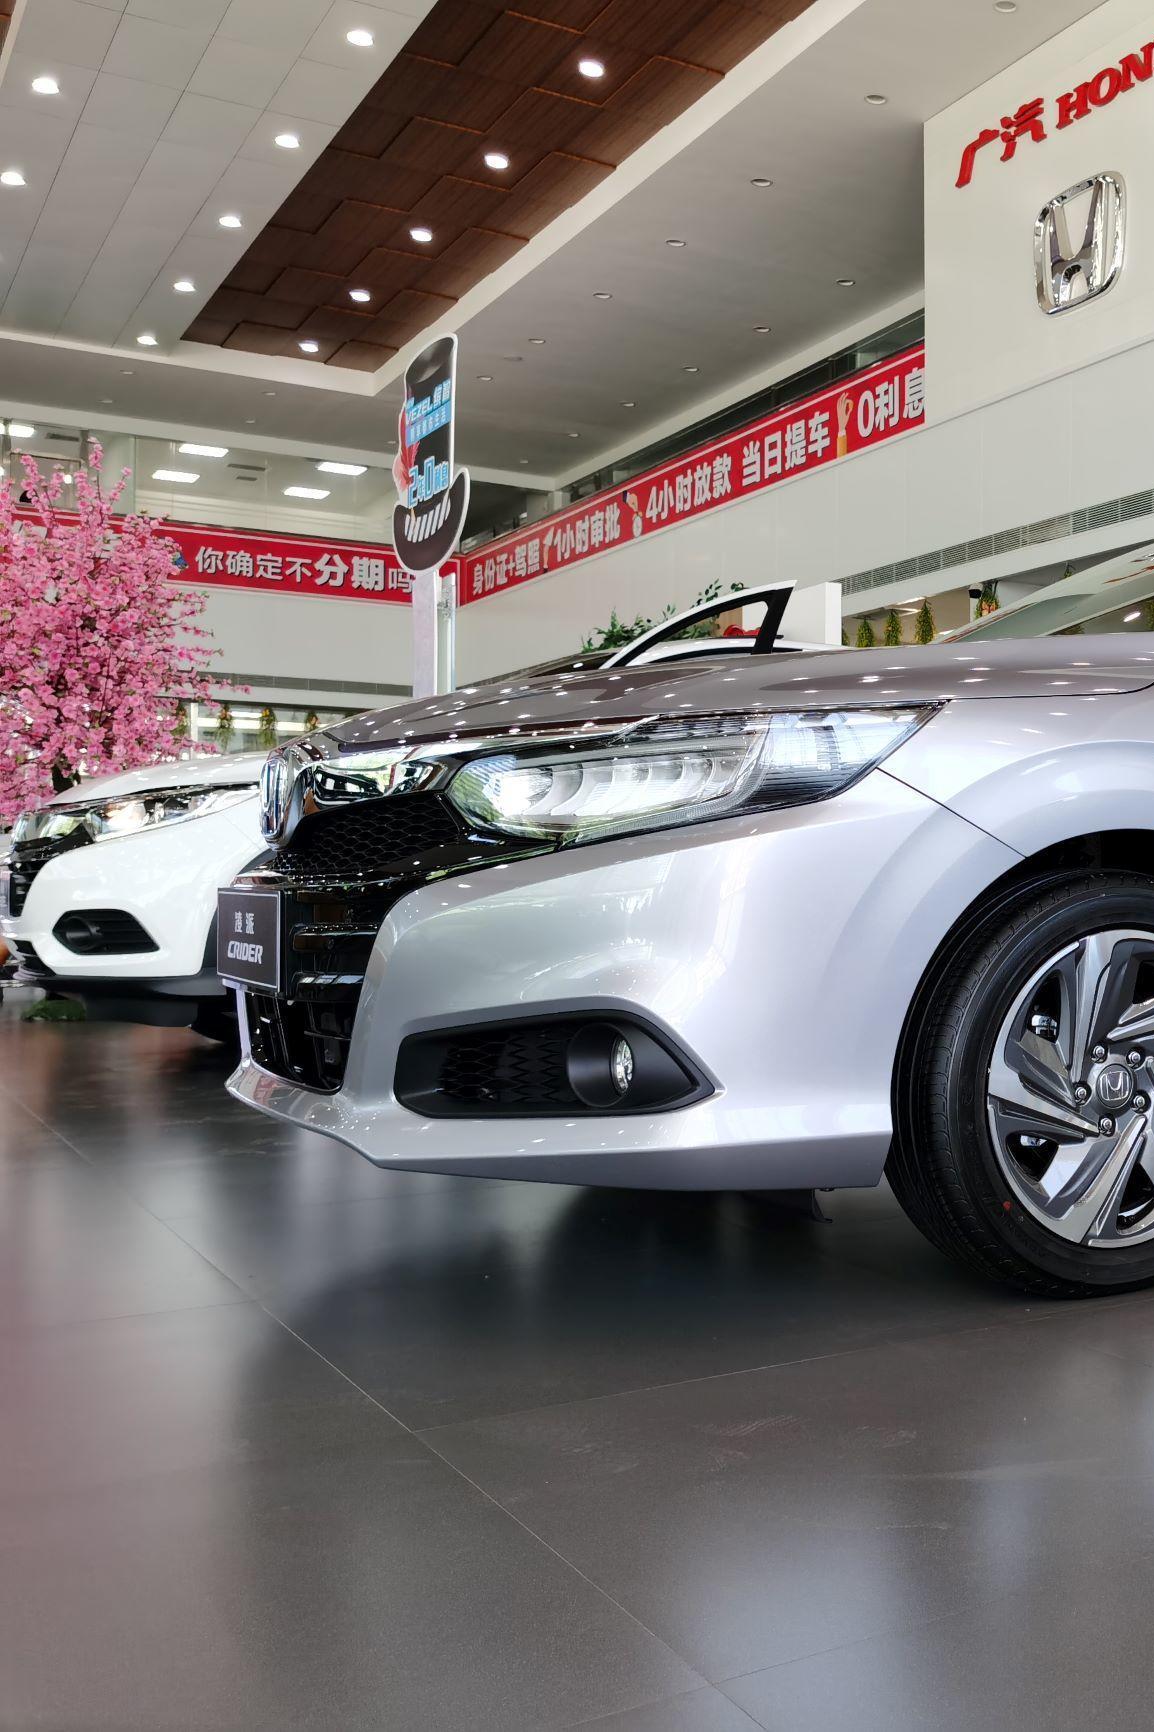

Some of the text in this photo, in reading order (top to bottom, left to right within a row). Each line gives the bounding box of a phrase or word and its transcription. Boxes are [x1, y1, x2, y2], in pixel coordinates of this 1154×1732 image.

[955, 97, 1047, 188] 广汽
[473, 367, 925, 596] 身份证+驾照 1小时审批 4小时放款 当日提车 0利息
[195, 546, 414, 593] 你确定不分期吗
[227, 940, 263, 965] CRIDER
